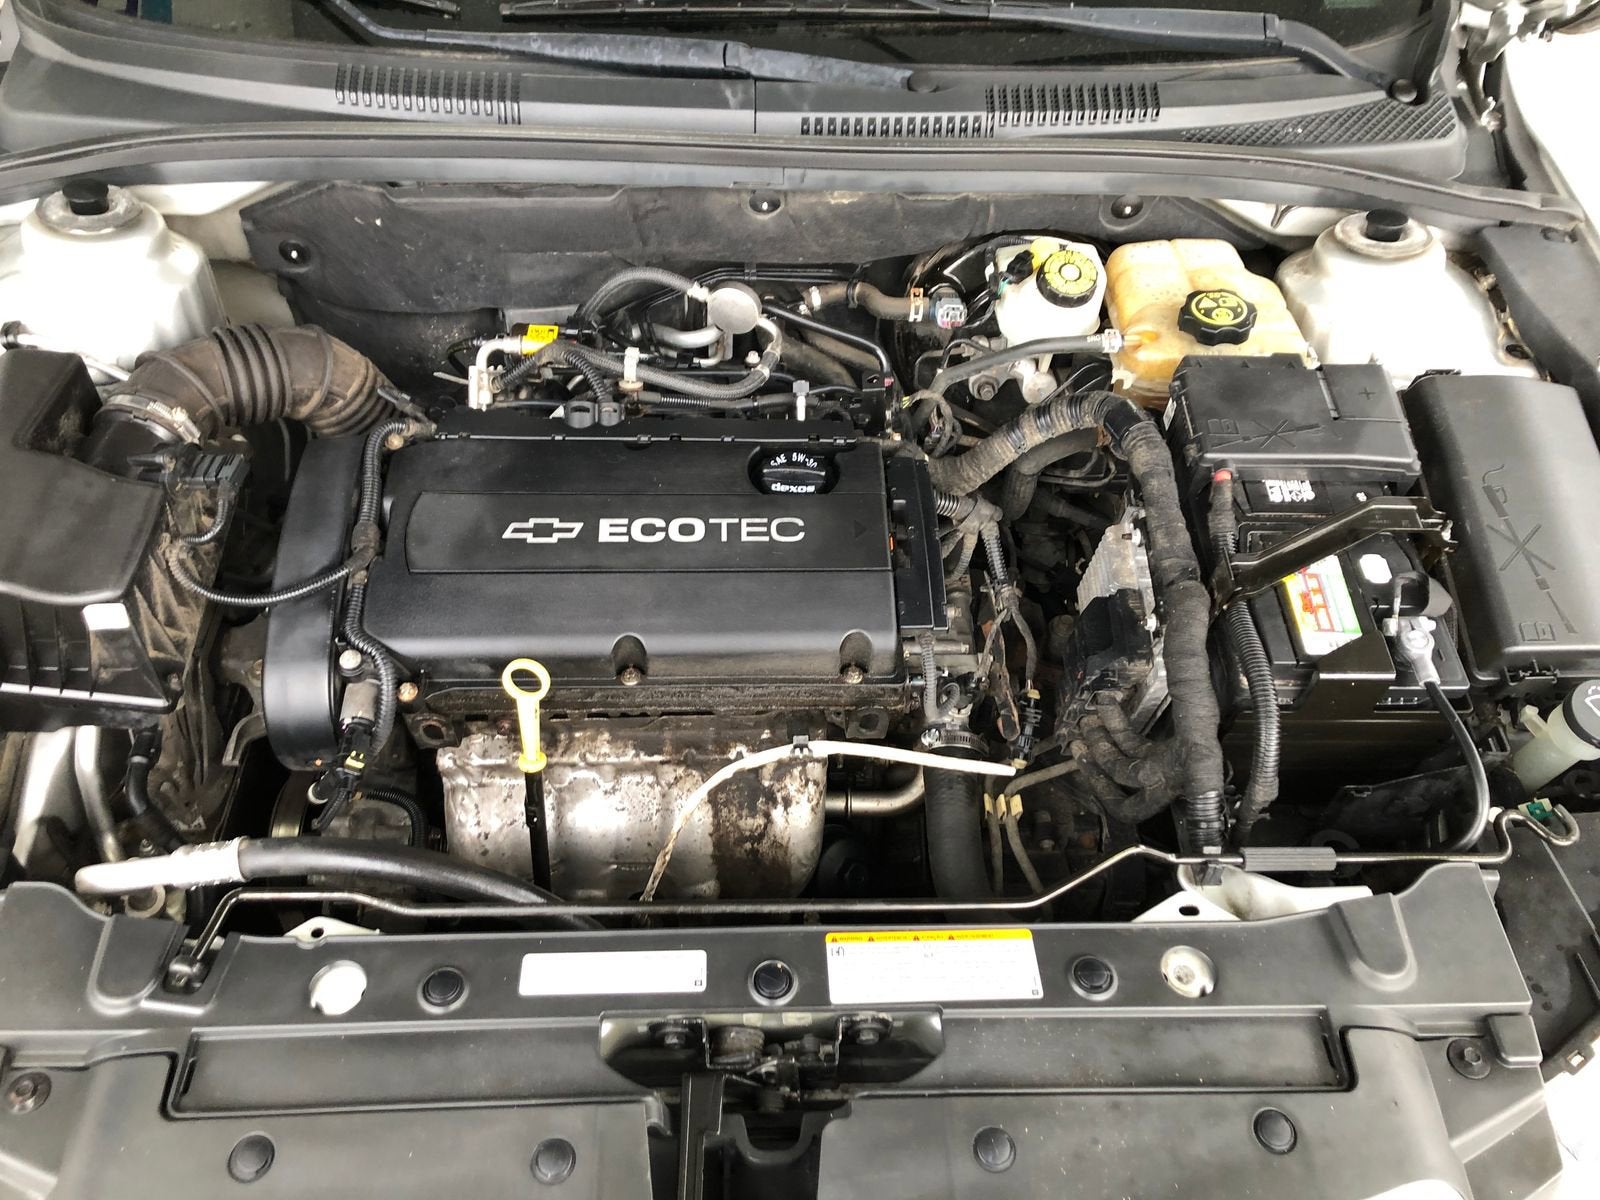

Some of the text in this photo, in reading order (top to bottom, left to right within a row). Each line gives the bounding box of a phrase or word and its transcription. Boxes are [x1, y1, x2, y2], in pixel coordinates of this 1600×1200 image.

[770, 453, 788, 467] SAE
[771, 482, 816, 493] dexos
[598, 517, 806, 543] ECOTEC
